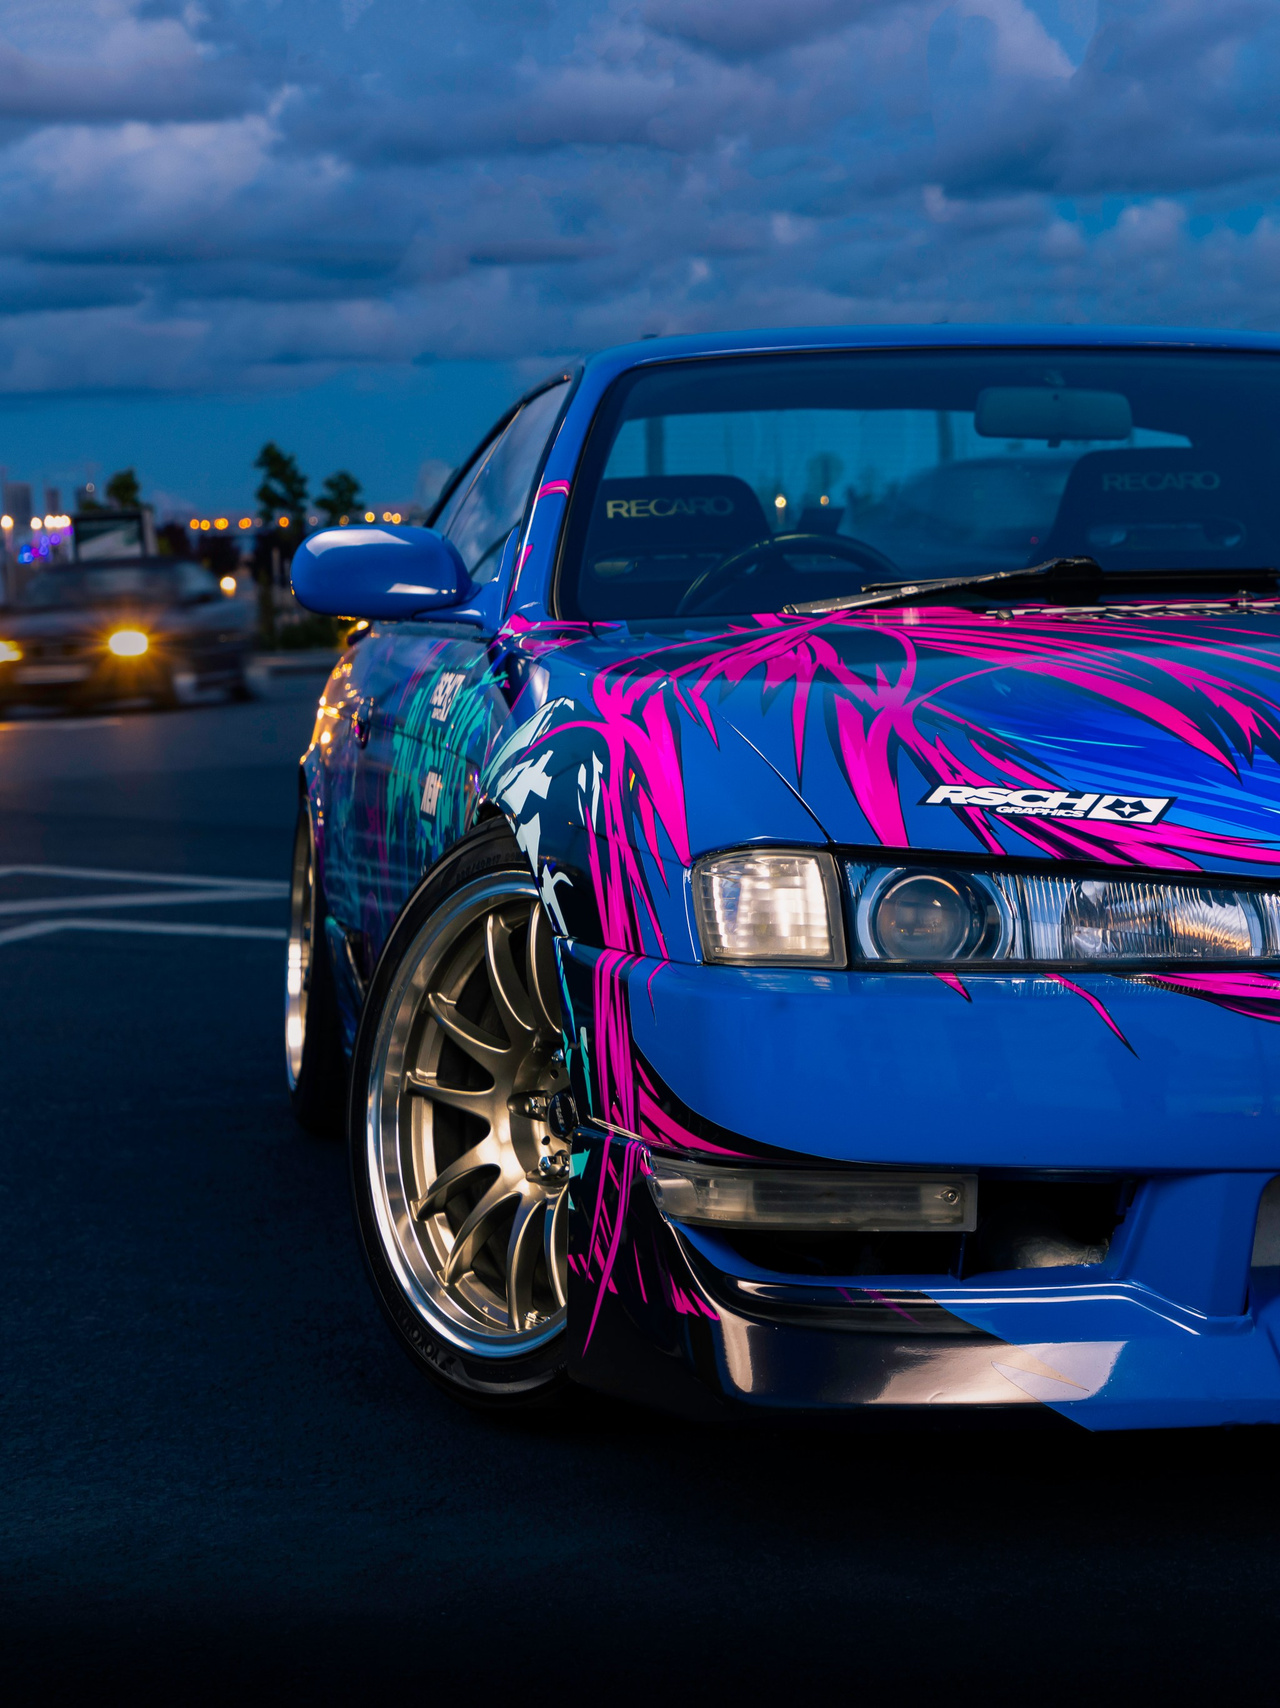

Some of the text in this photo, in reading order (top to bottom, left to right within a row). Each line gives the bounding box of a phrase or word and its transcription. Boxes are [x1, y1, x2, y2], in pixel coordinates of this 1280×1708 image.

[1103, 471, 1220, 491] RECARO
[606, 497, 734, 518] RECARO
[926, 785, 1100, 811] RSCH
[995, 805, 1086, 819] GRAPHICS
